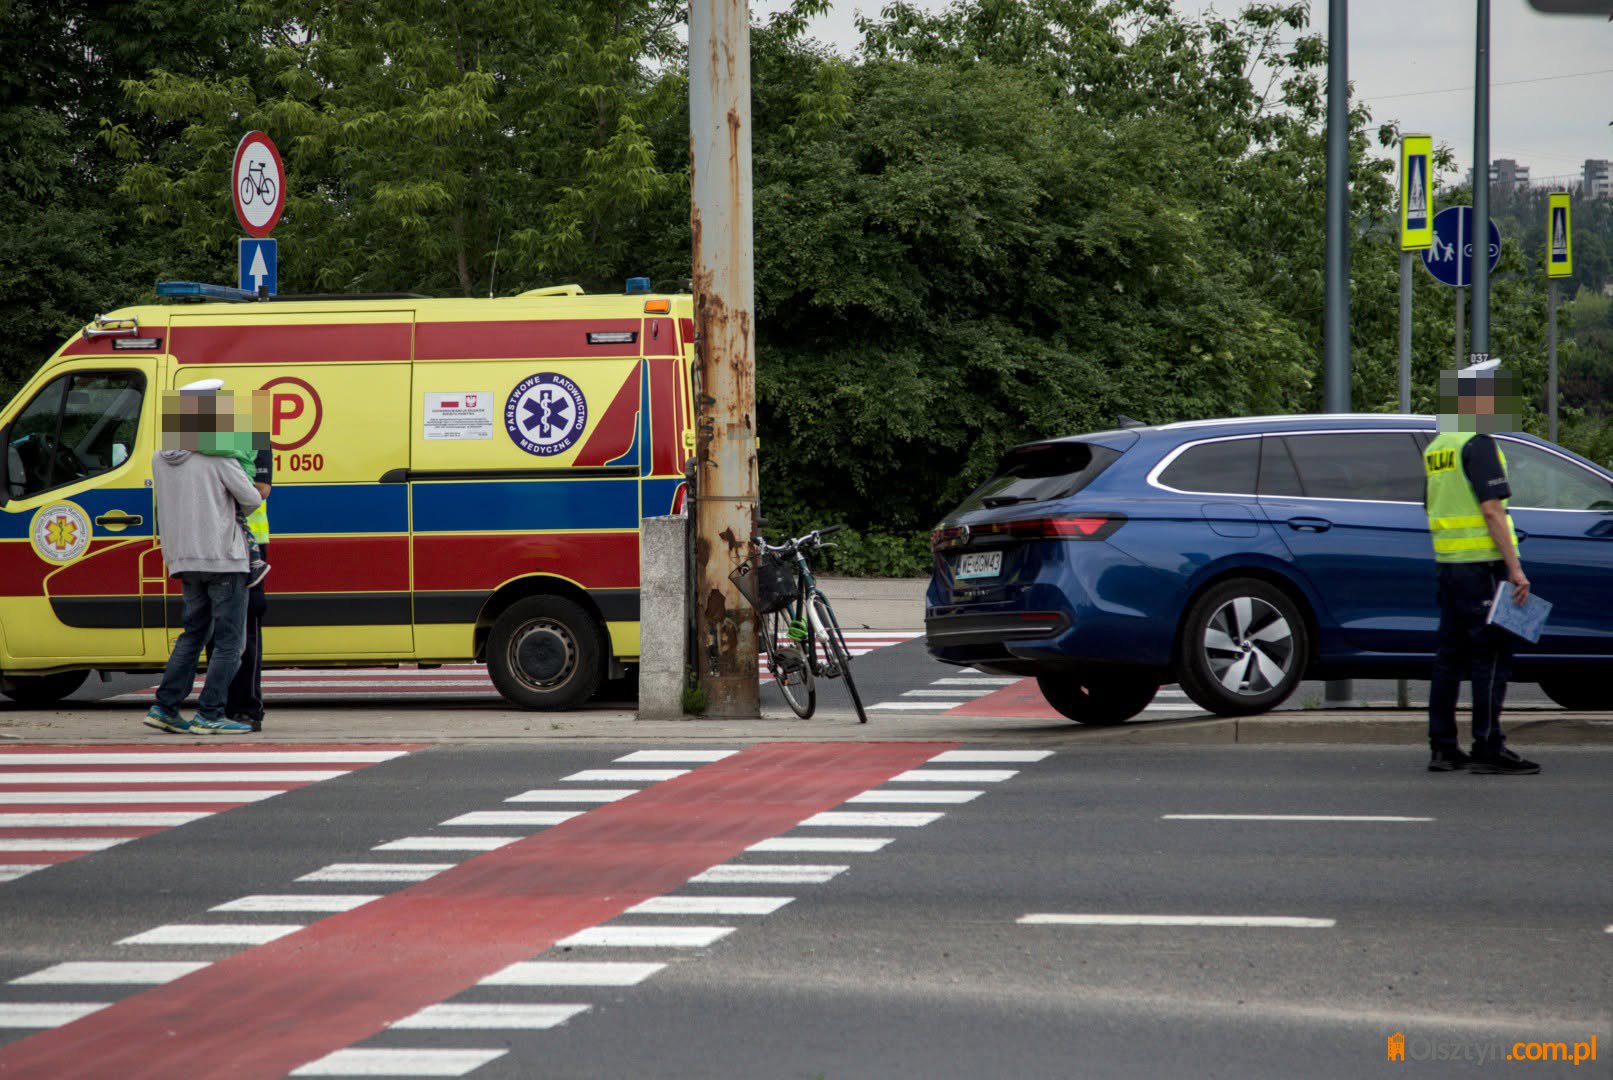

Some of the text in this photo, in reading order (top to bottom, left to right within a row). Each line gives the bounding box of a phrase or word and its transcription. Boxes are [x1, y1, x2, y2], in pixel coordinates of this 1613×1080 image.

[1471, 353, 1488, 364] 037
[507, 376, 585, 432] PAŃSTWOWE RATOWNICTWO
[272, 393, 304, 436] P
[520, 438, 571, 453] MEDYCZNE
[290, 453, 324, 472] 050
